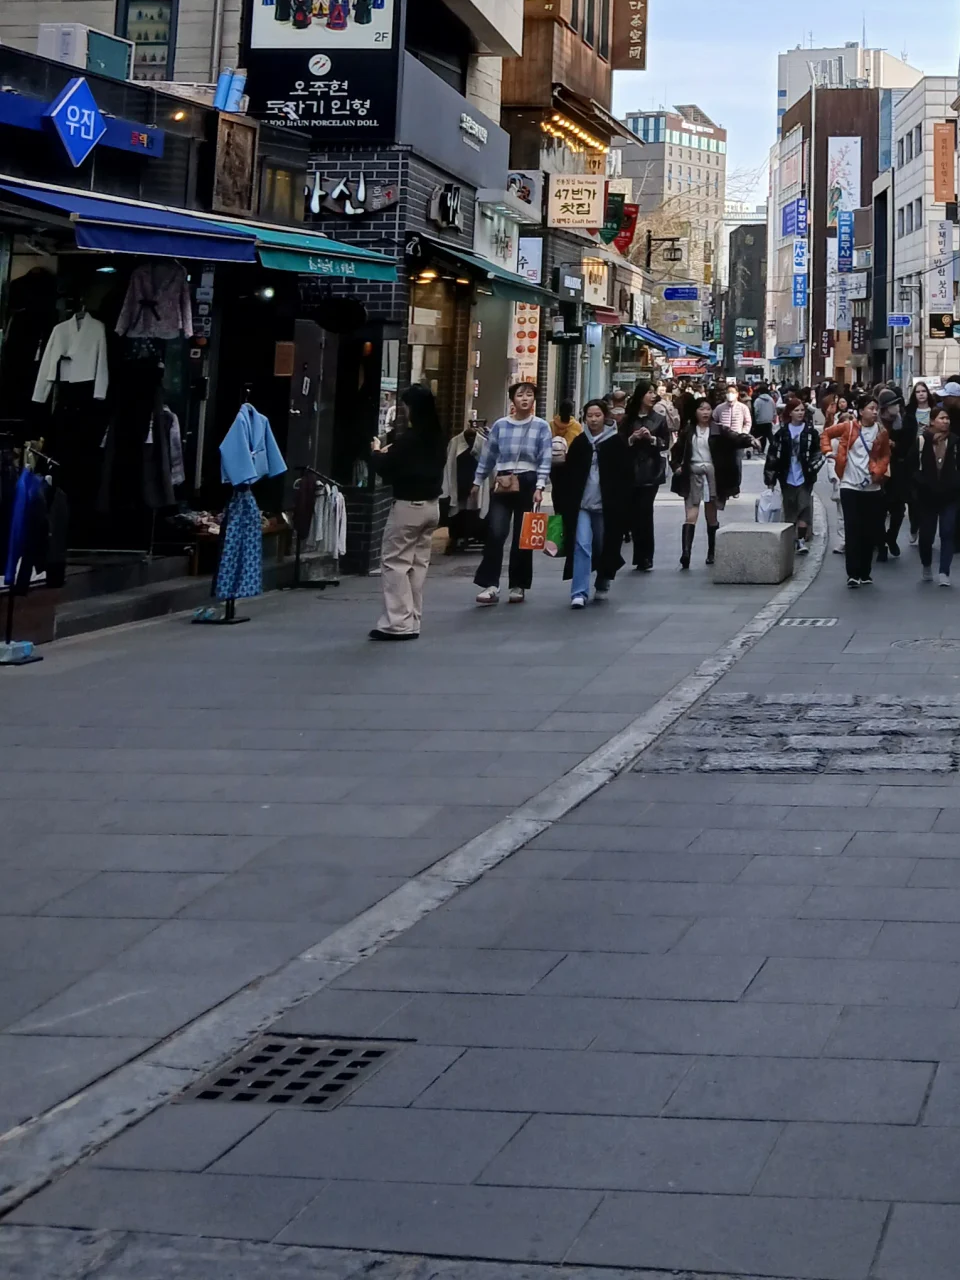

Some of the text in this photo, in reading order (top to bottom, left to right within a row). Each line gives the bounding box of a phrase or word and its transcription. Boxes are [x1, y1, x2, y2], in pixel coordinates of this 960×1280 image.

[374, 32, 390, 43] 2F
[288, 79, 349, 97] 오주현
[265, 98, 371, 116] 도자기 인형
[65, 105, 96, 140] 우진
[311, 119, 356, 127] PORCELAIN
[357, 119, 380, 127] DOLL
[554, 187, 598, 201] 47번가
[559, 202, 592, 215] 찻집
[531, 519, 545, 535] 50
